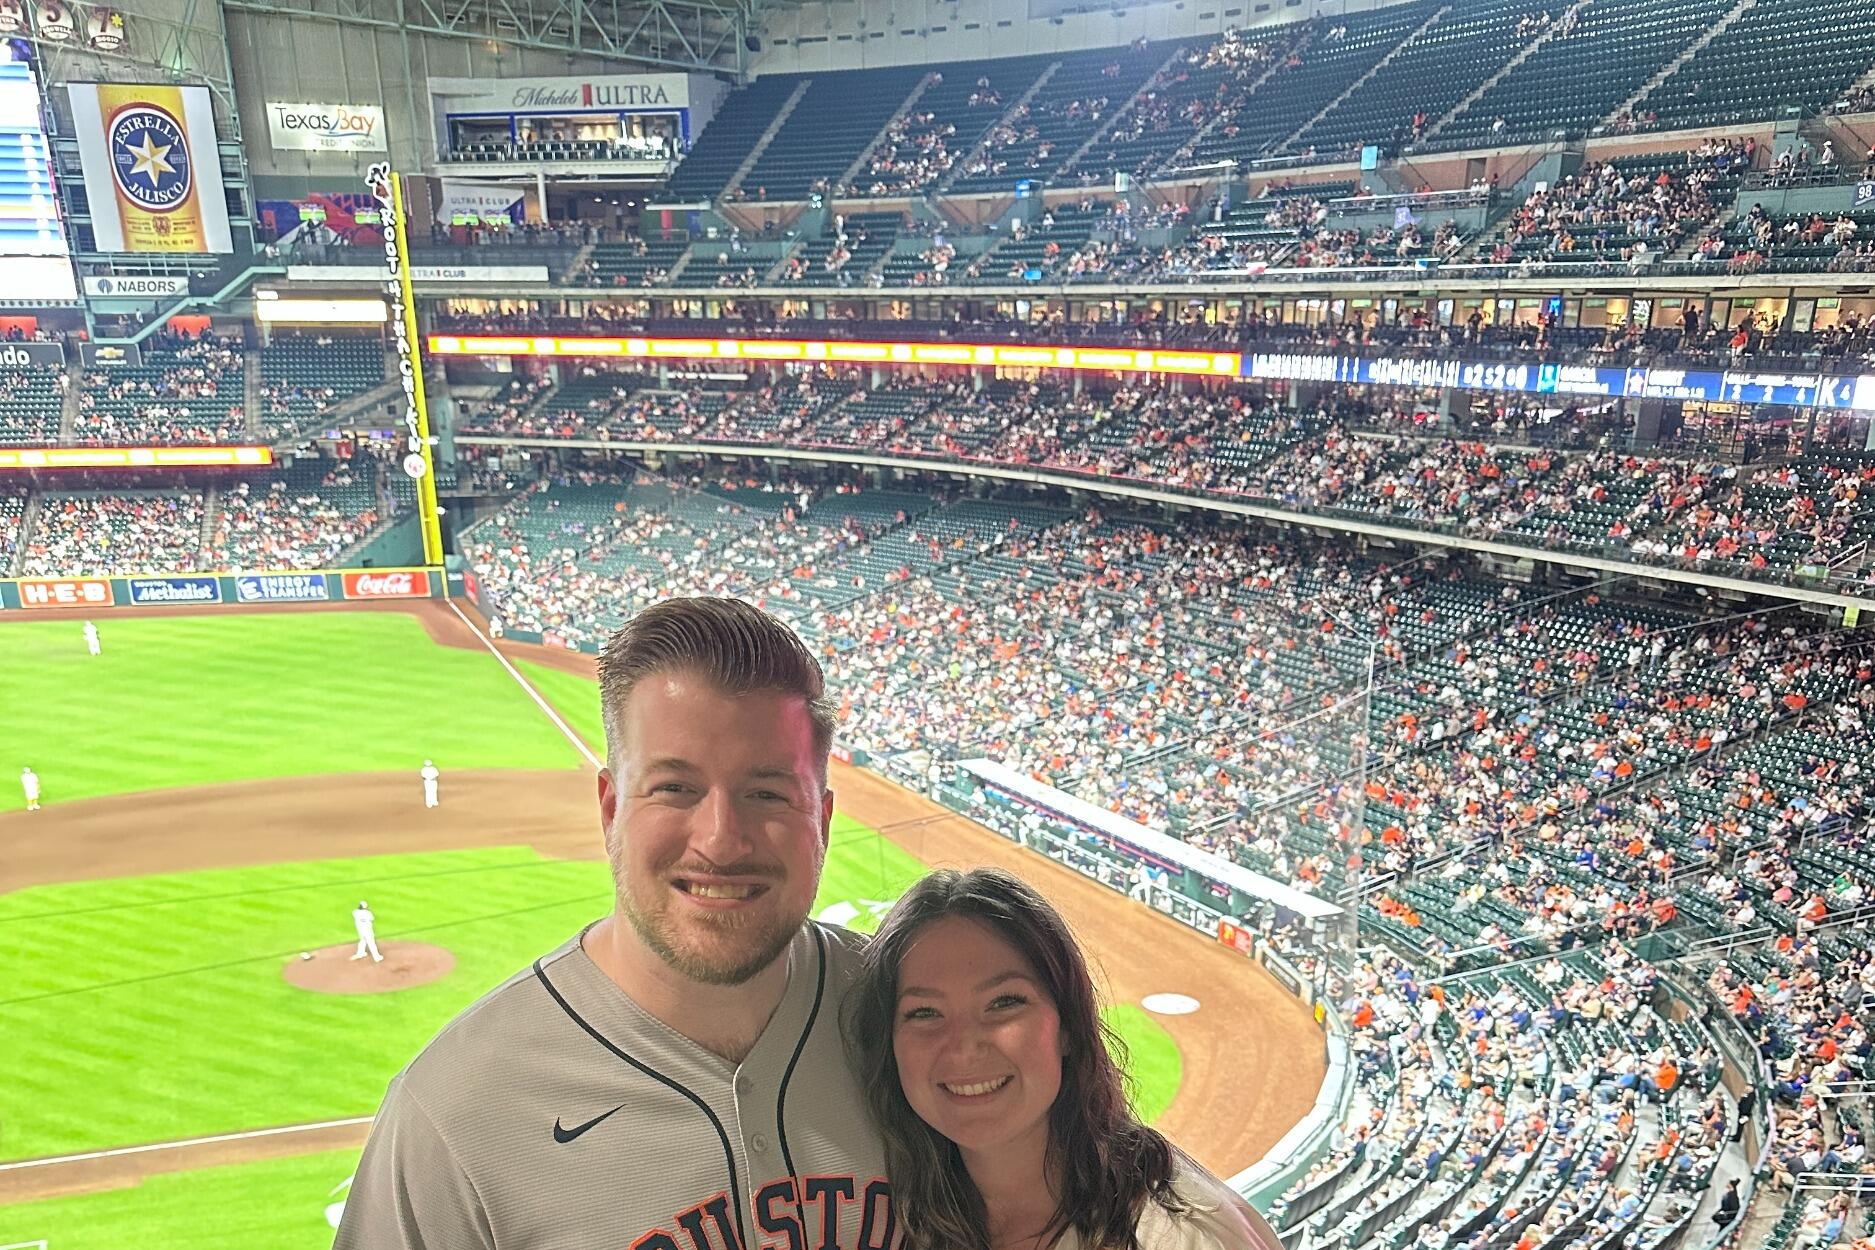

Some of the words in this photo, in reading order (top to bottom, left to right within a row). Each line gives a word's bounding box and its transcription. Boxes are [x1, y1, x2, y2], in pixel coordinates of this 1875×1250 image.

[512, 86, 578, 107] Michelob
[596, 84, 669, 105] ULTRA
[115, 115, 180, 146] ESTRELLA
[275, 107, 331, 129] Texas
[330, 109, 375, 136] Bay
[128, 181, 184, 203] JALISCO
[1858, 184, 1873, 199] 98
[379, 207, 399, 274] ROOT
[442, 270, 466, 278] CLUB
[117, 280, 177, 293] NABORS
[0, 346, 30, 366] do
[259, 576, 311, 588] ENERGY
[261, 586, 325, 598] TRANSFER
